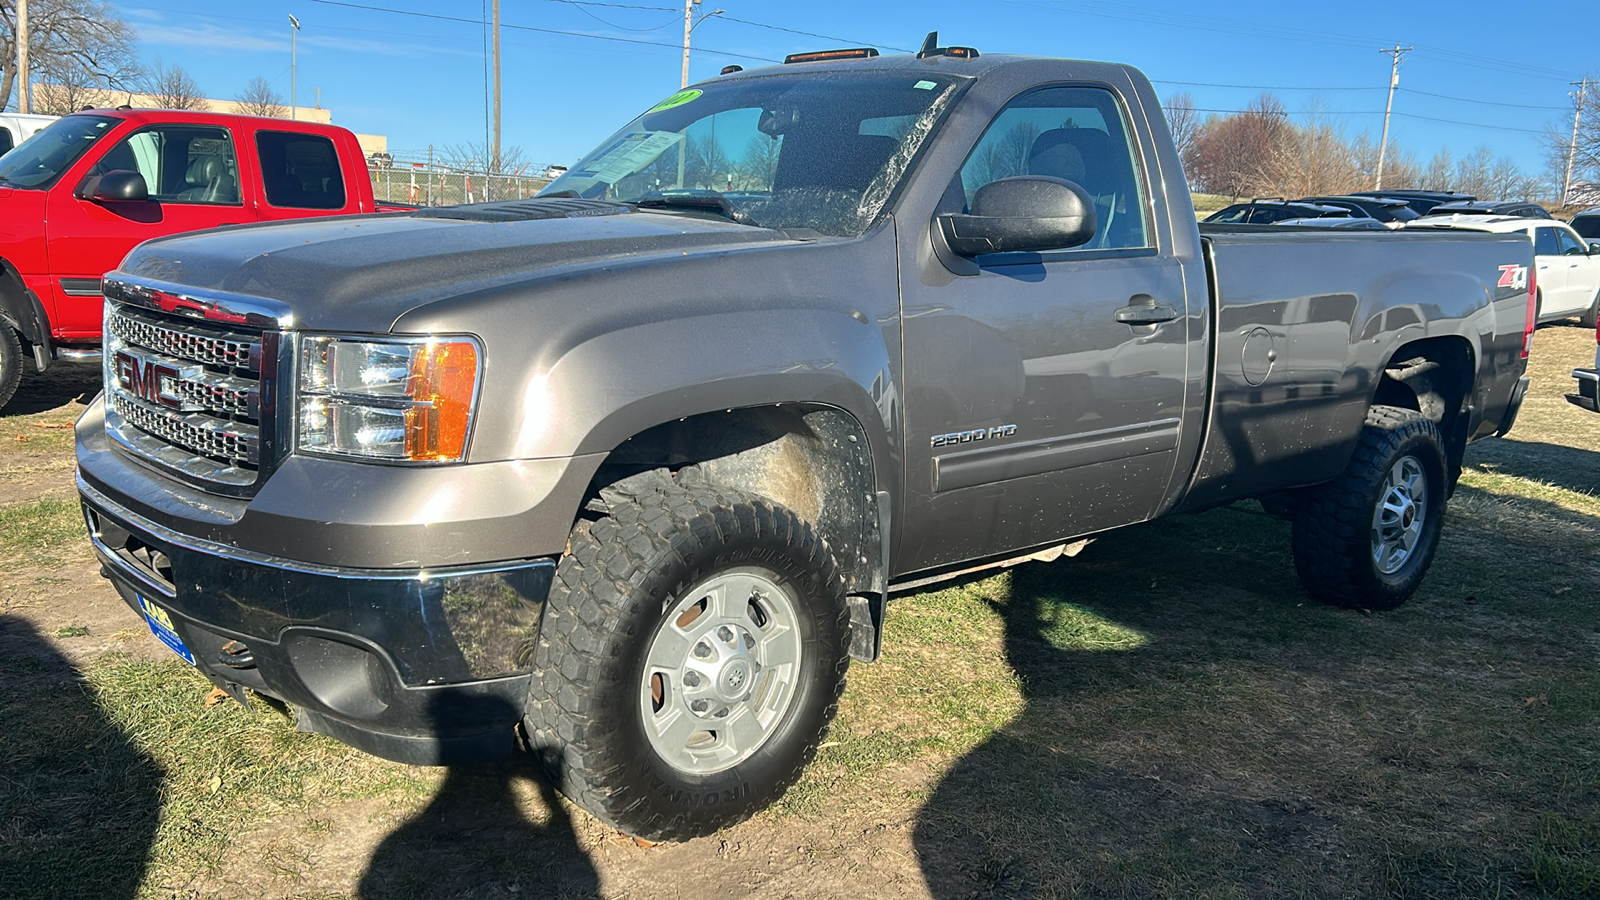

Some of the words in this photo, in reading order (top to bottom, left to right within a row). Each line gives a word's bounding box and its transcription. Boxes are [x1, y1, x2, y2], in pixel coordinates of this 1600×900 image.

[1497, 264, 1528, 288] Z71
[115, 349, 182, 412] GMC
[930, 428, 986, 448] 2500
[988, 423, 1018, 440] HD
[714, 546, 823, 601] COUNTRY
